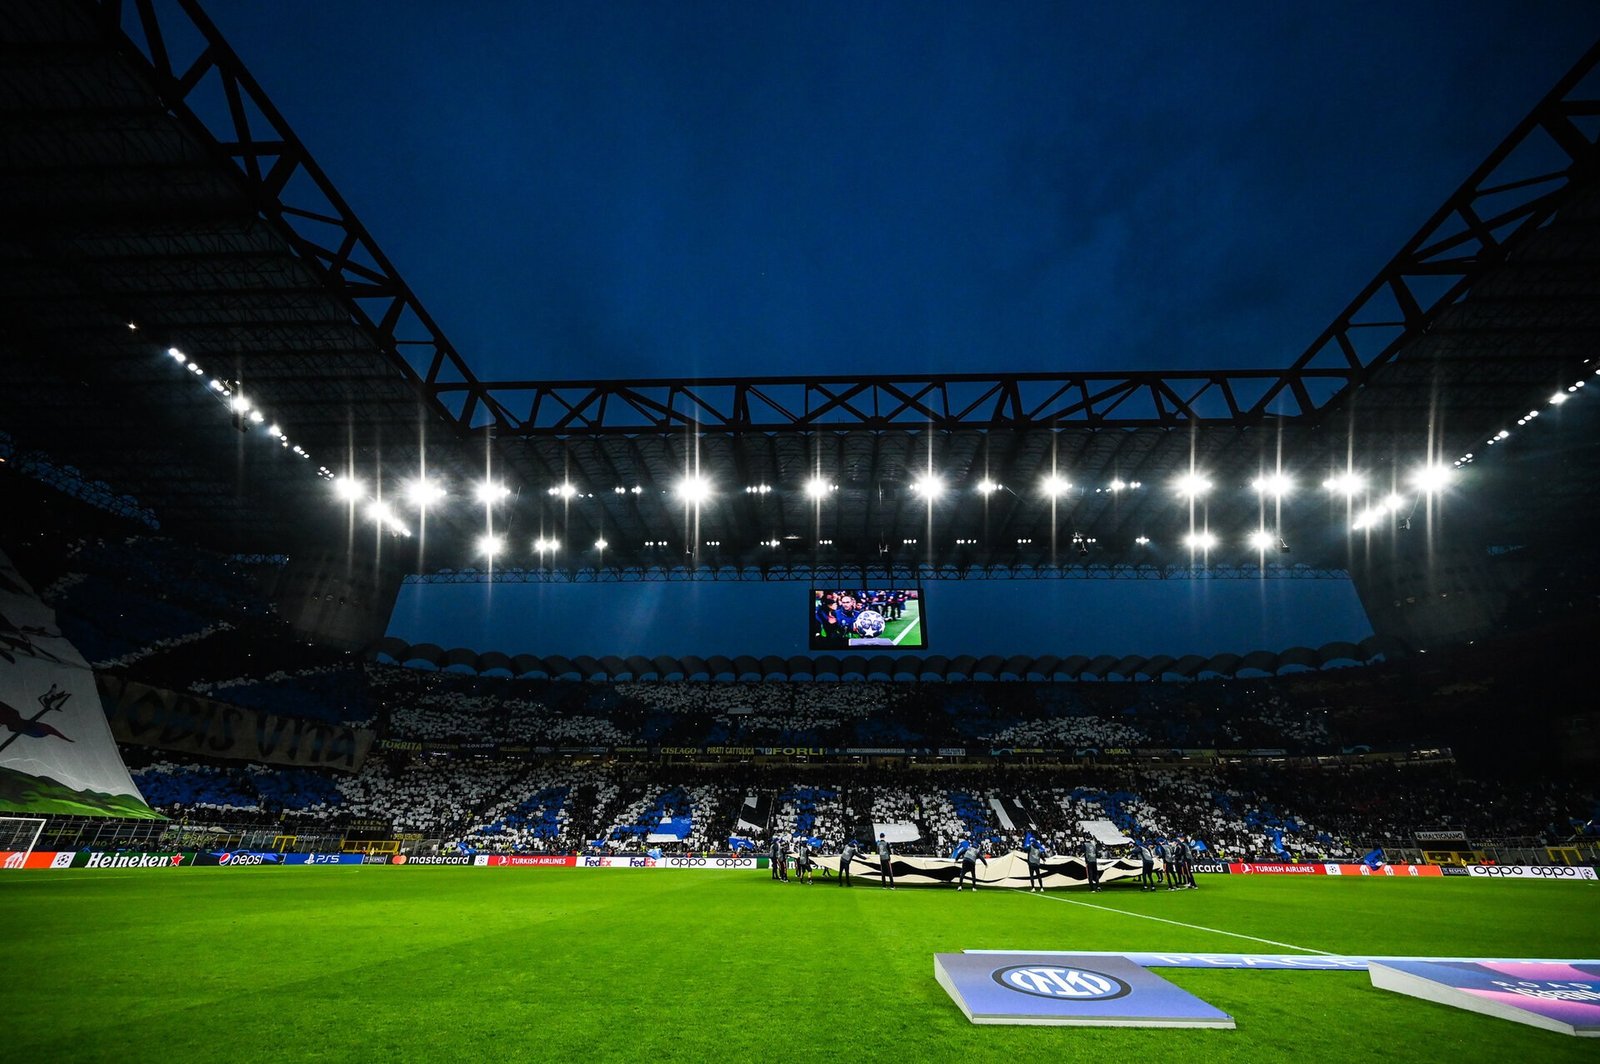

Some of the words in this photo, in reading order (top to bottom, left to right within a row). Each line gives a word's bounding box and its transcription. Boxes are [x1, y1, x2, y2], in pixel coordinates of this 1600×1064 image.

[84, 852, 169, 869] Heineken
[230, 853, 265, 867] pepsi
[315, 855, 341, 864] PS5
[408, 855, 470, 865] mastercard
[539, 858, 567, 866] AIRLINES
[585, 857, 612, 867] FedEx
[629, 857, 656, 867] FedEx
[670, 858, 707, 868] oppo
[716, 858, 752, 868] oppo
[1255, 865, 1284, 873] TURKISH
[1474, 865, 1523, 878] oppo
[1530, 866, 1576, 878] oppo
[1153, 955, 1367, 968] PEACE
